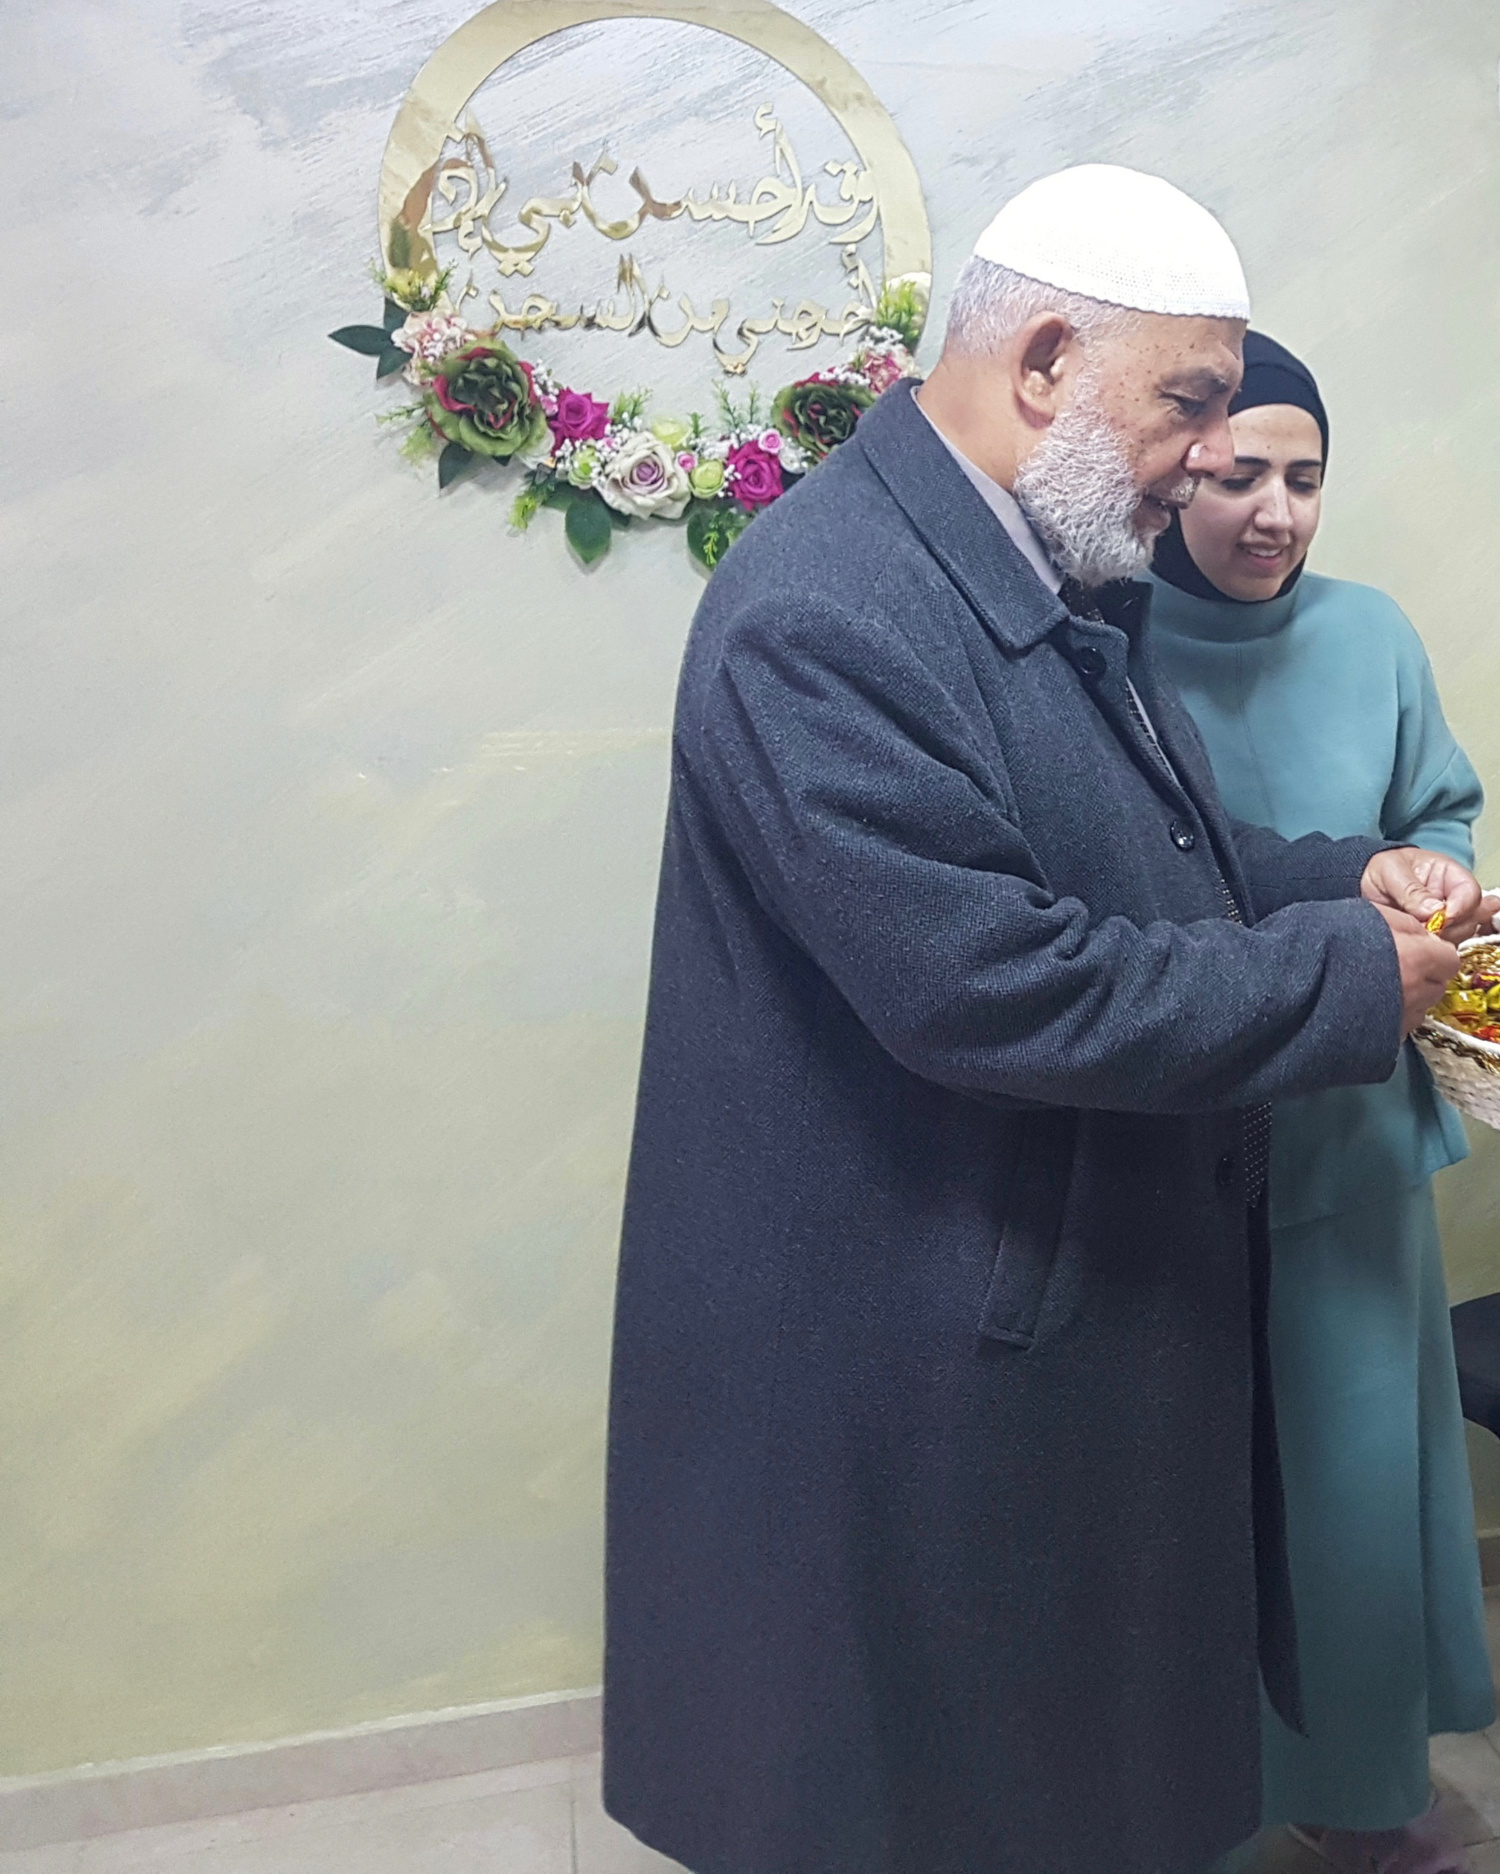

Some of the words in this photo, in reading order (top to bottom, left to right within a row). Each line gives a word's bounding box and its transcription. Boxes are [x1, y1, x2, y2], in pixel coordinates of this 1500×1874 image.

[478, 162, 584, 278] بي
[582, 101, 802, 241] أحسن
[760, 160, 878, 245] وقد
[648, 273, 730, 348] من
